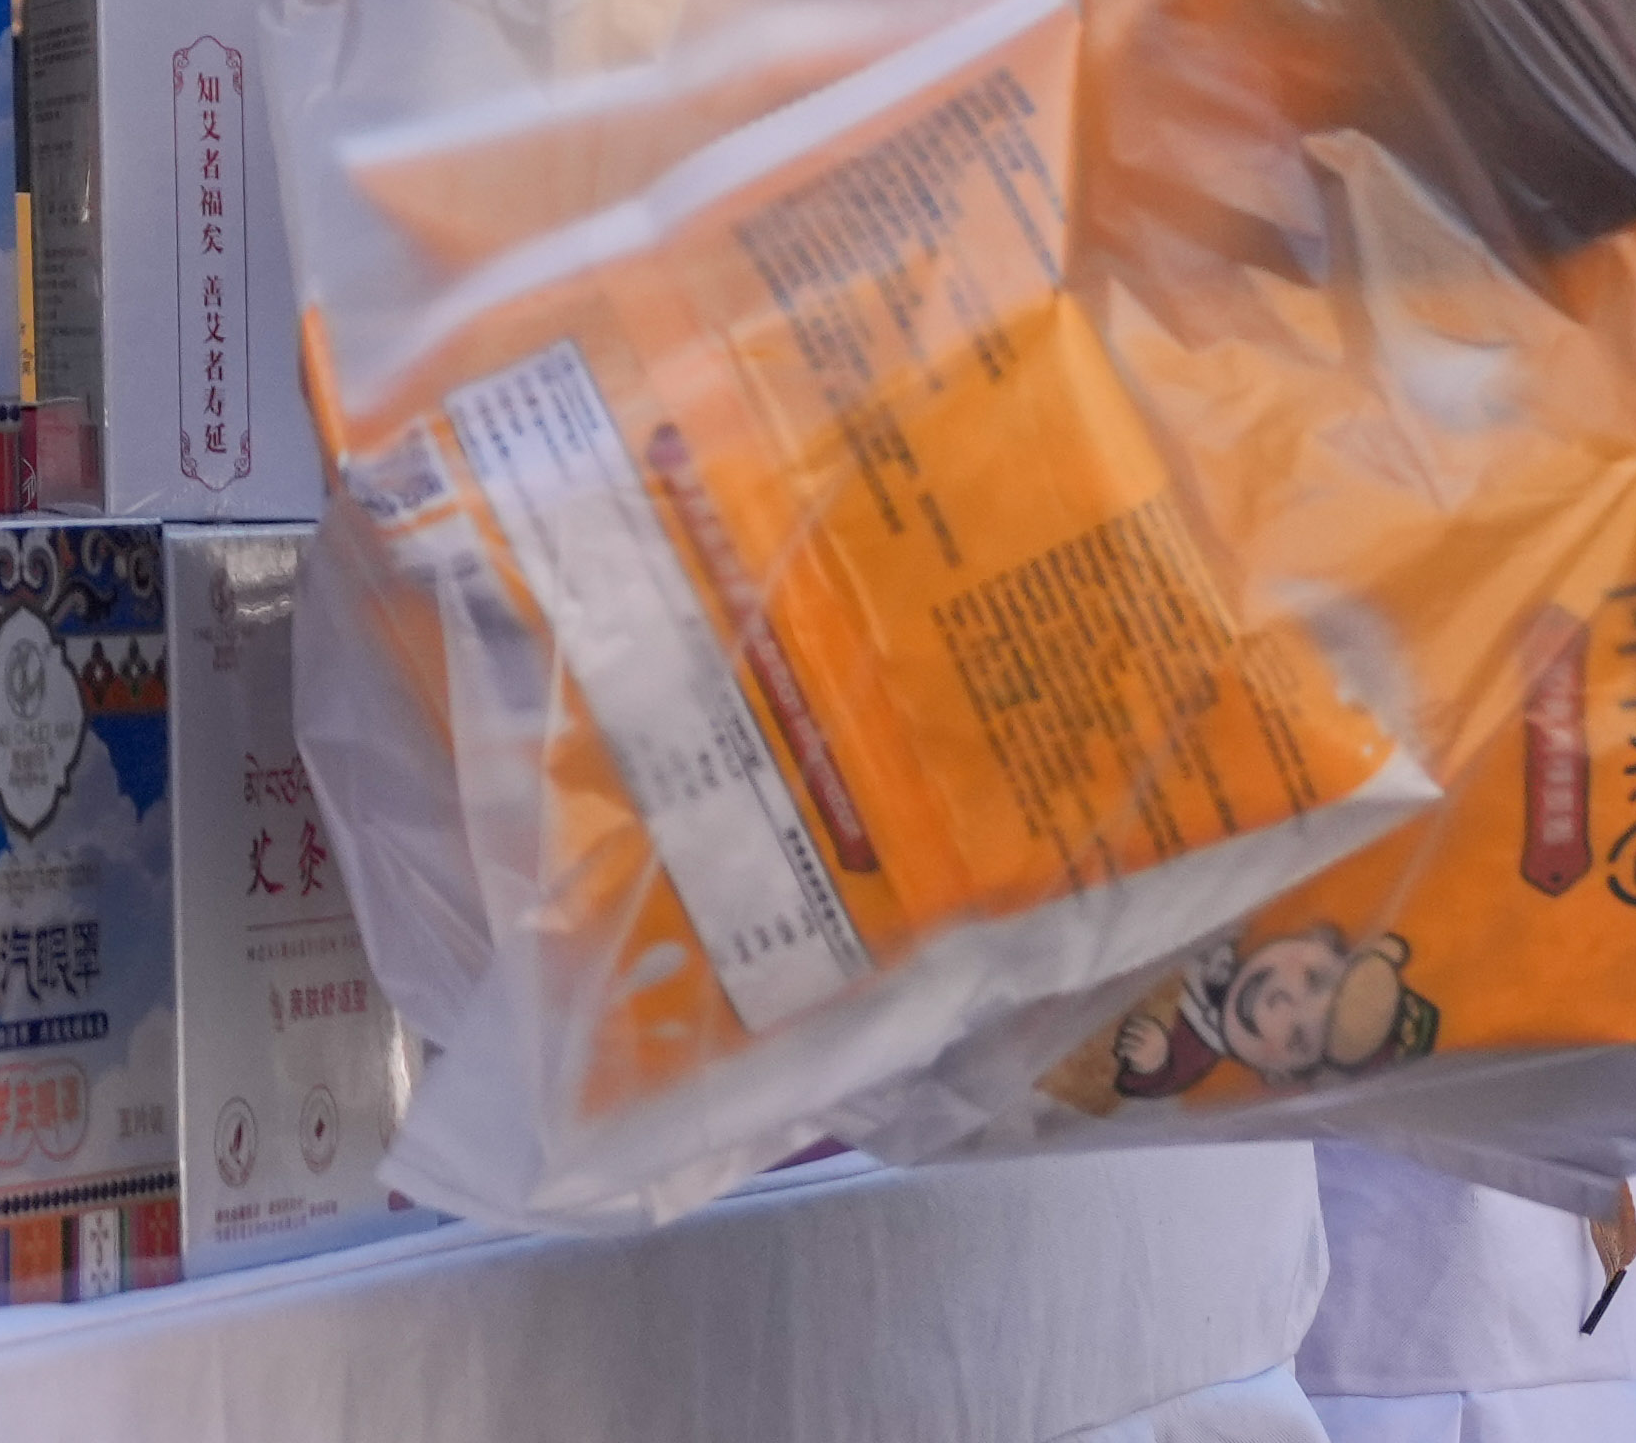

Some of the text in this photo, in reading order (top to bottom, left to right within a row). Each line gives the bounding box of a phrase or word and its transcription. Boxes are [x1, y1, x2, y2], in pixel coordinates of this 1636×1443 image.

[196, 71, 228, 456] 知艾者福矣 善艾者寿延
[246, 817, 328, 899] 艾灸
